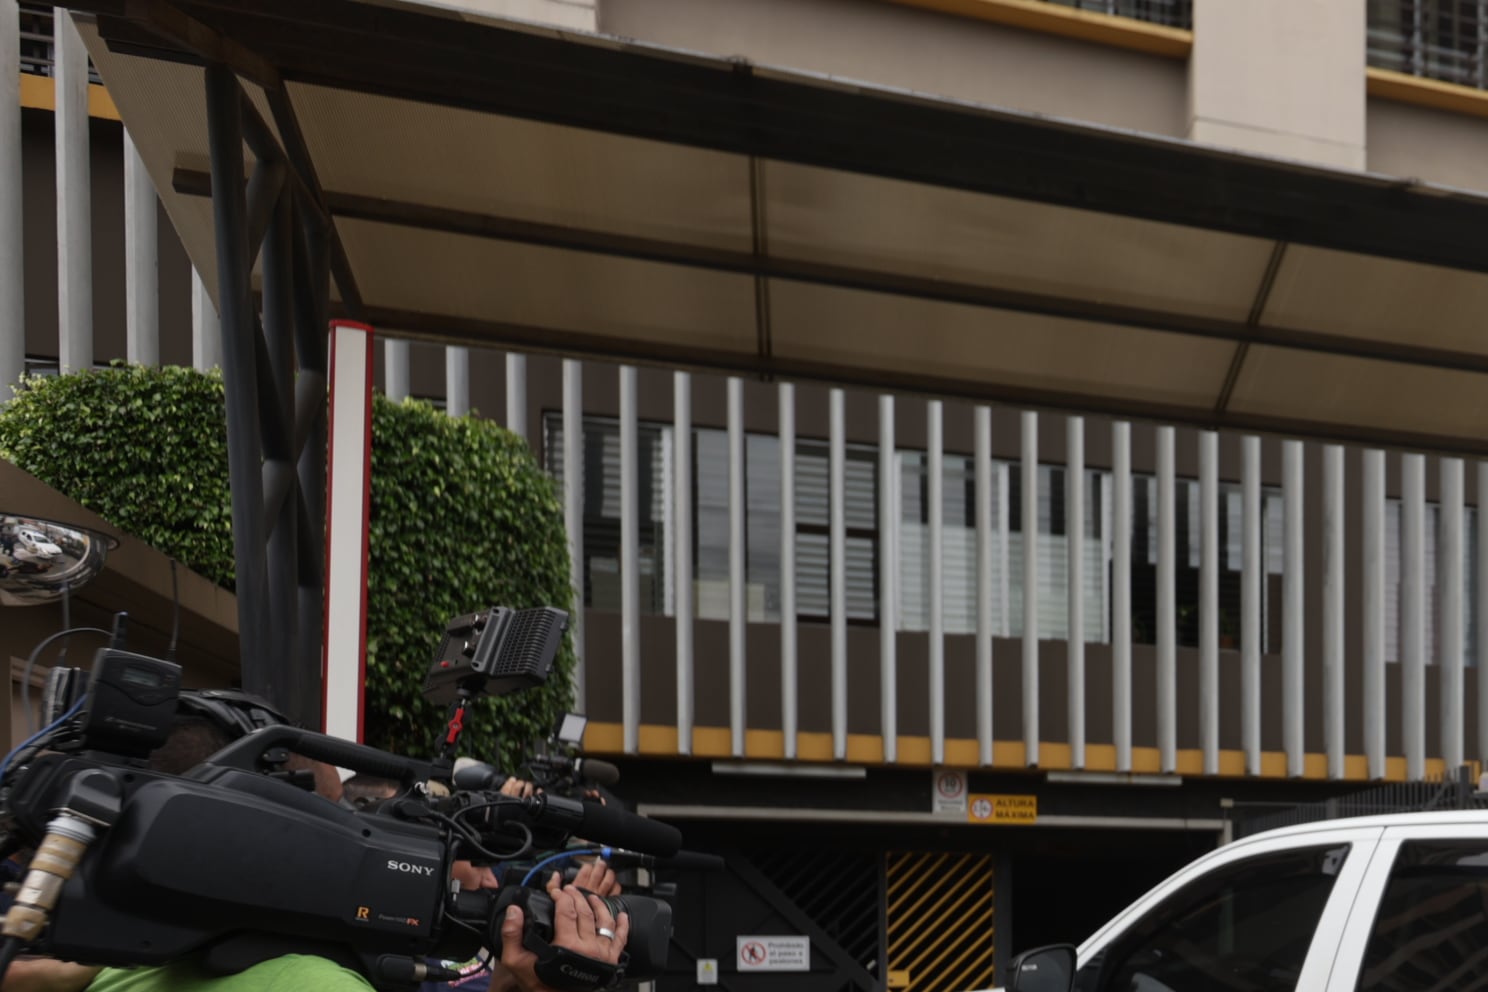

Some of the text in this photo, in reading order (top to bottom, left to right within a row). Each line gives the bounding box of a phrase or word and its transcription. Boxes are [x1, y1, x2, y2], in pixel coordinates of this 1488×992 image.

[996, 799, 1034, 808] ALTURA
[387, 860, 435, 876] SONY
[357, 906, 369, 919] R
[560, 964, 600, 983] Canon
